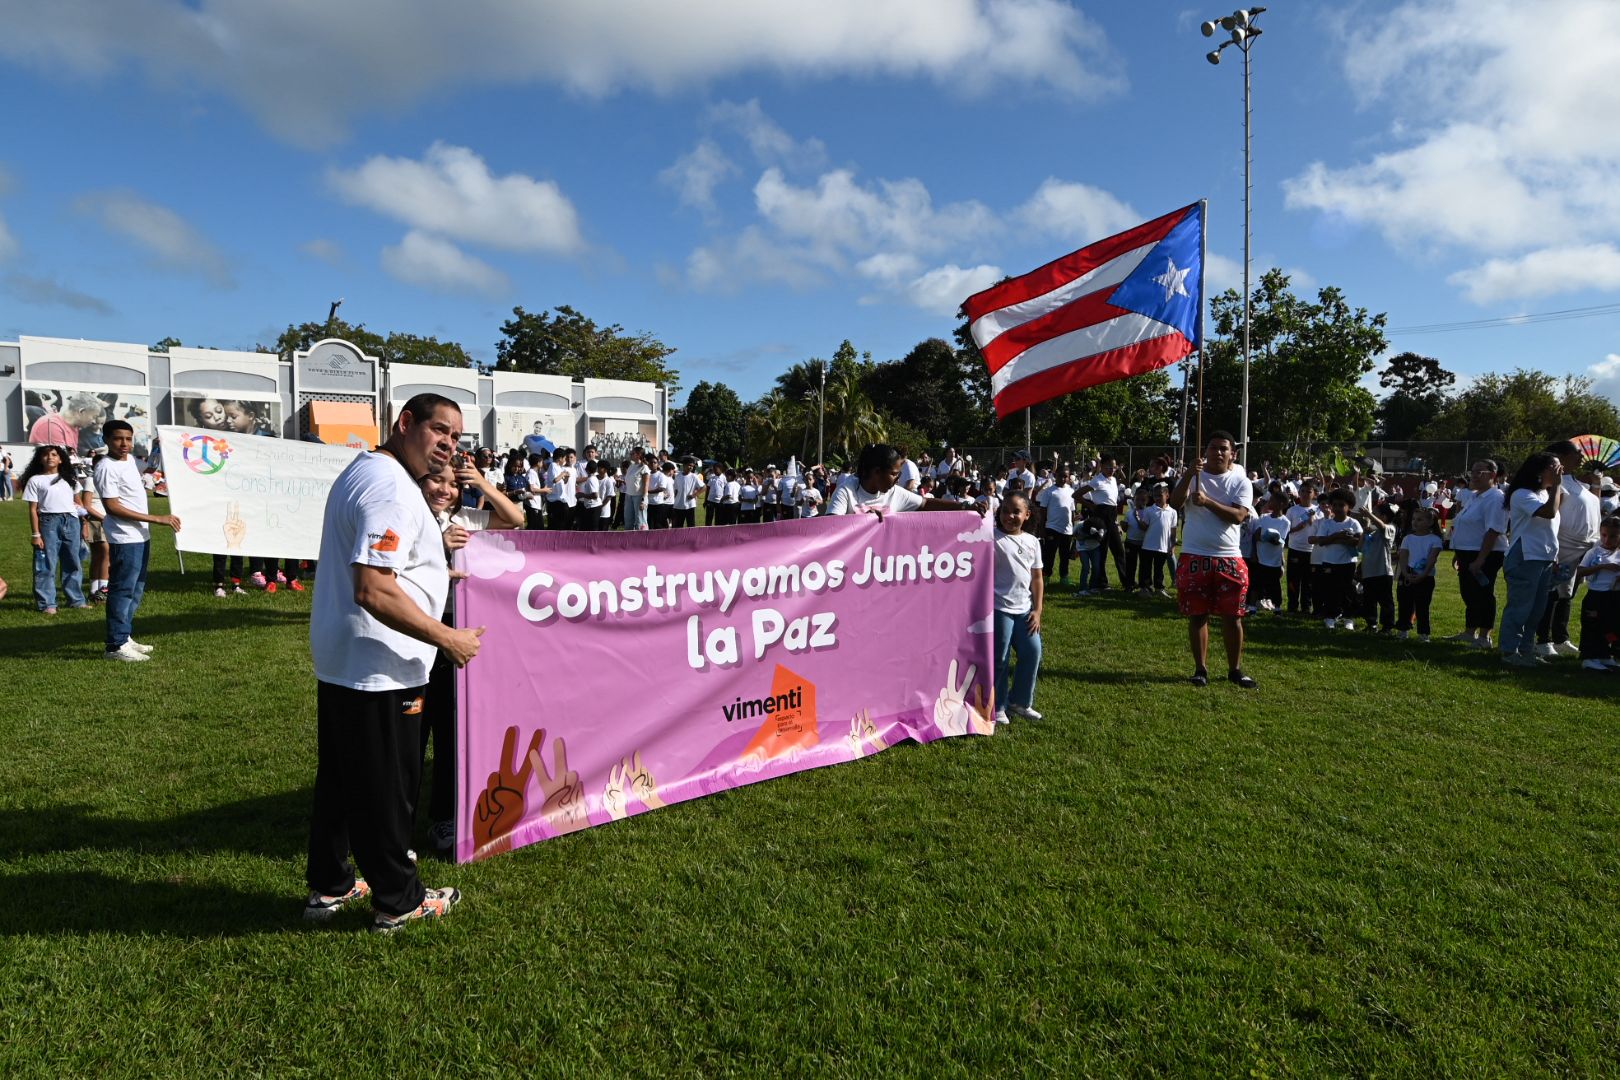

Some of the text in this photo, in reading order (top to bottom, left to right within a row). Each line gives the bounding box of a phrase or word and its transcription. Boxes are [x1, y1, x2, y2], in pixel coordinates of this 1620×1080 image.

[303, 447, 346, 465] Interme
[225, 464, 332, 513] Construyamo
[516, 546, 973, 622] Construyamos Juntos
[687, 608, 836, 668] la Paz
[722, 686, 802, 722] vimenti
